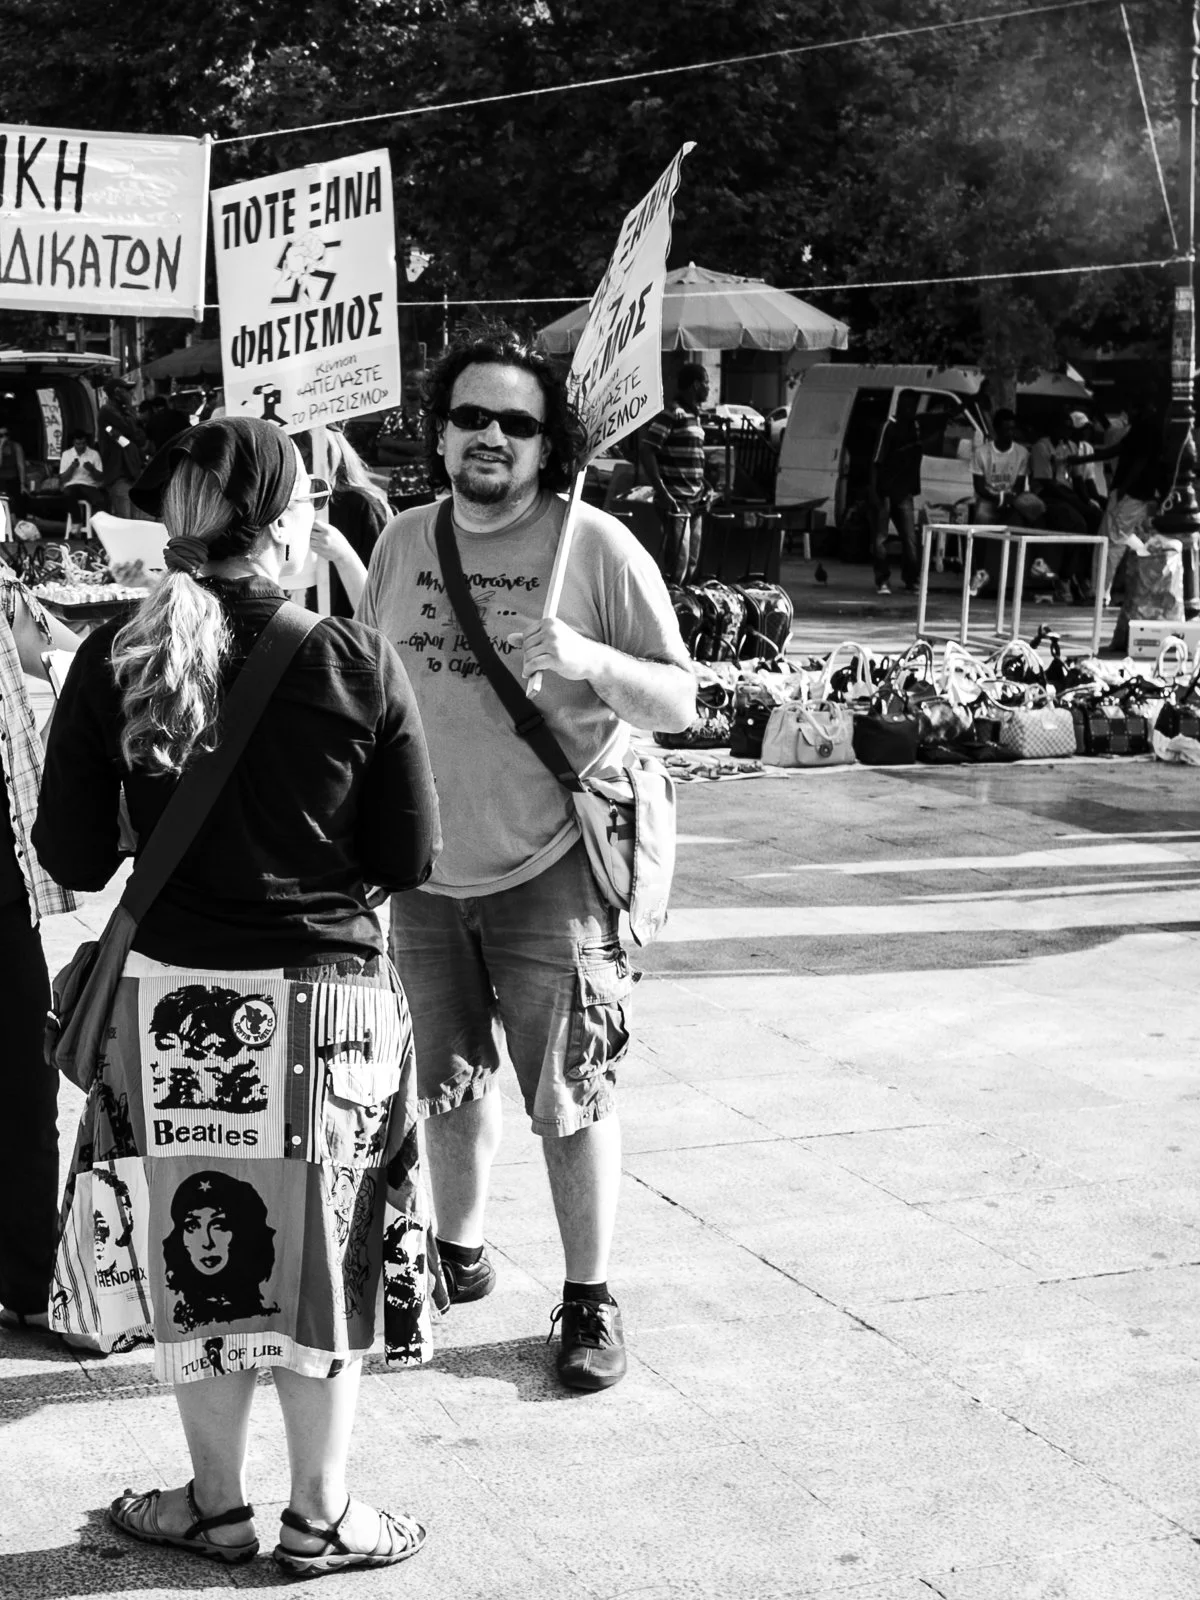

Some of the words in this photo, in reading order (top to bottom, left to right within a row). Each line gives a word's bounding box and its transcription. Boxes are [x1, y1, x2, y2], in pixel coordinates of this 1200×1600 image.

[222, 188, 296, 250] ΠΟΤΕ
[308, 166, 382, 229] ΞΑΝΑ
[231, 291, 384, 369] ΦΑΣΙΣΜΟΣ
[152, 1119, 259, 1147] Beatles
[227, 1347, 248, 1361] OF
